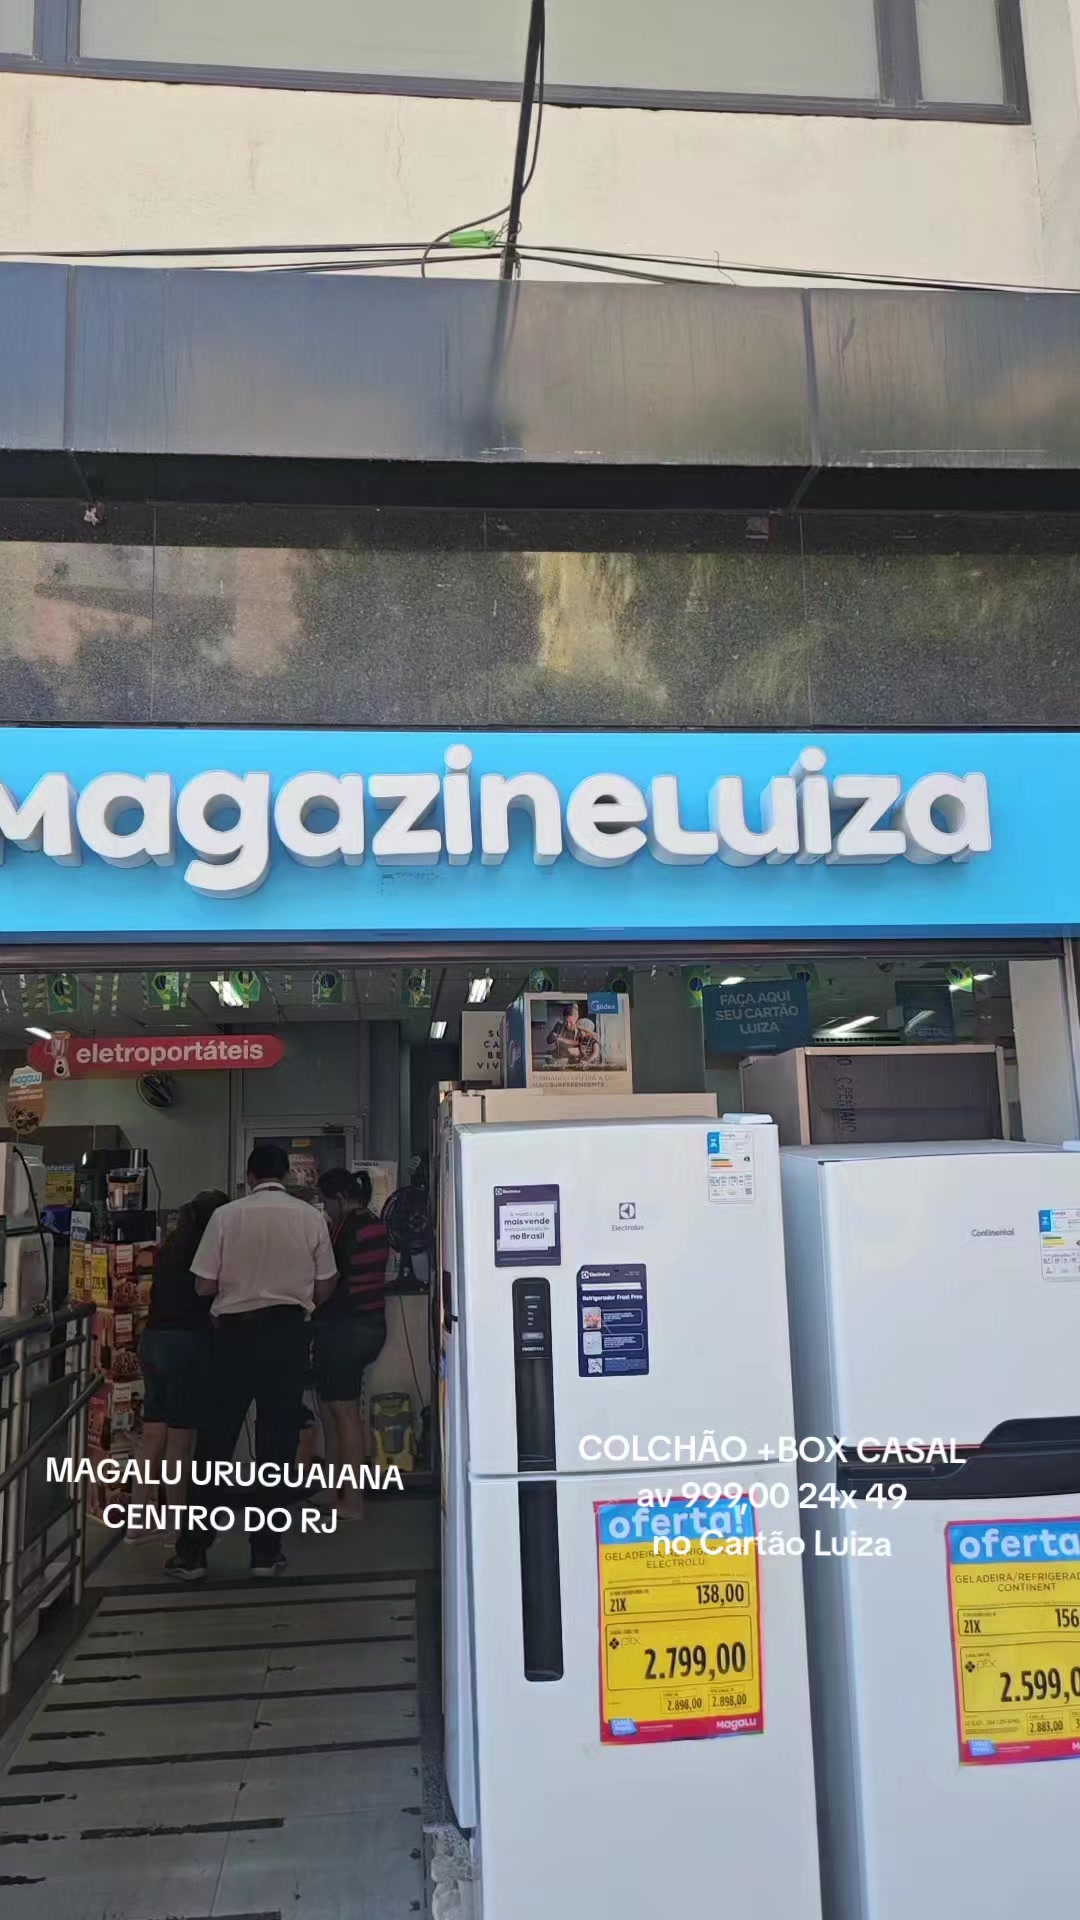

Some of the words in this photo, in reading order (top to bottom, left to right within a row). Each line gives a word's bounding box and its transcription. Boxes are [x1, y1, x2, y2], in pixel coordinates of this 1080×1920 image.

[720, 993, 755, 1007] FAÇA
[757, 990, 791, 1003] AQUI
[715, 1009, 742, 1020] SEU
[744, 1003, 799, 1019] CARTÃO
[740, 1022, 780, 1034] LUIZA
[76, 1040, 264, 1066] eletroportáteis
[524, 1217, 550, 1225] vende
[611, 1224, 645, 1232] Electrolux
[971, 1228, 1015, 1237] Continental
[646, 1557, 705, 1569] ELECTROLU
[997, 1582, 1057, 1592] CONTINENT
[610, 1597, 627, 1612] 21X
[696, 1583, 745, 1606] 138,00
[963, 1620, 981, 1634] 21X
[644, 1641, 747, 1681] 2.799,00
[667, 1697, 703, 1711] 2.898,00
[712, 1693, 747, 1708] 2.898,00
[1029, 1720, 1064, 1733] 2.883,00
